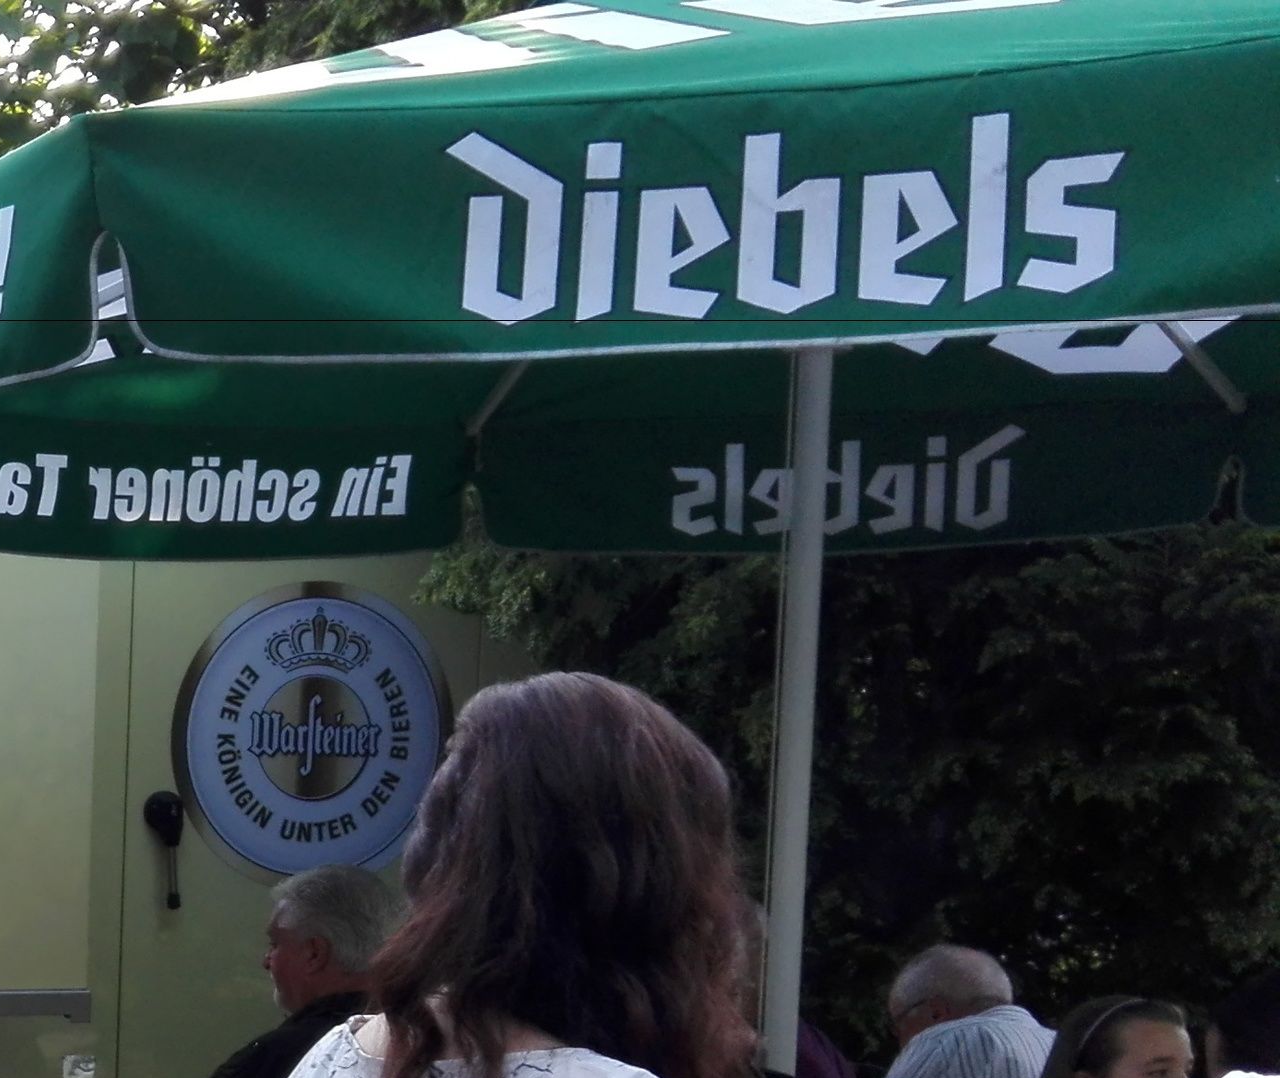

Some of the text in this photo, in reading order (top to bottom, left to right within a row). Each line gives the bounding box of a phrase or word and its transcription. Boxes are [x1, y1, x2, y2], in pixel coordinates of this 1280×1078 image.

[445, 112, 1126, 325] Diebels
[216, 664, 411, 843] EINE KÖNIGIN UNTER DEN BIEREN
[247, 693, 383, 777] Warsteiner
